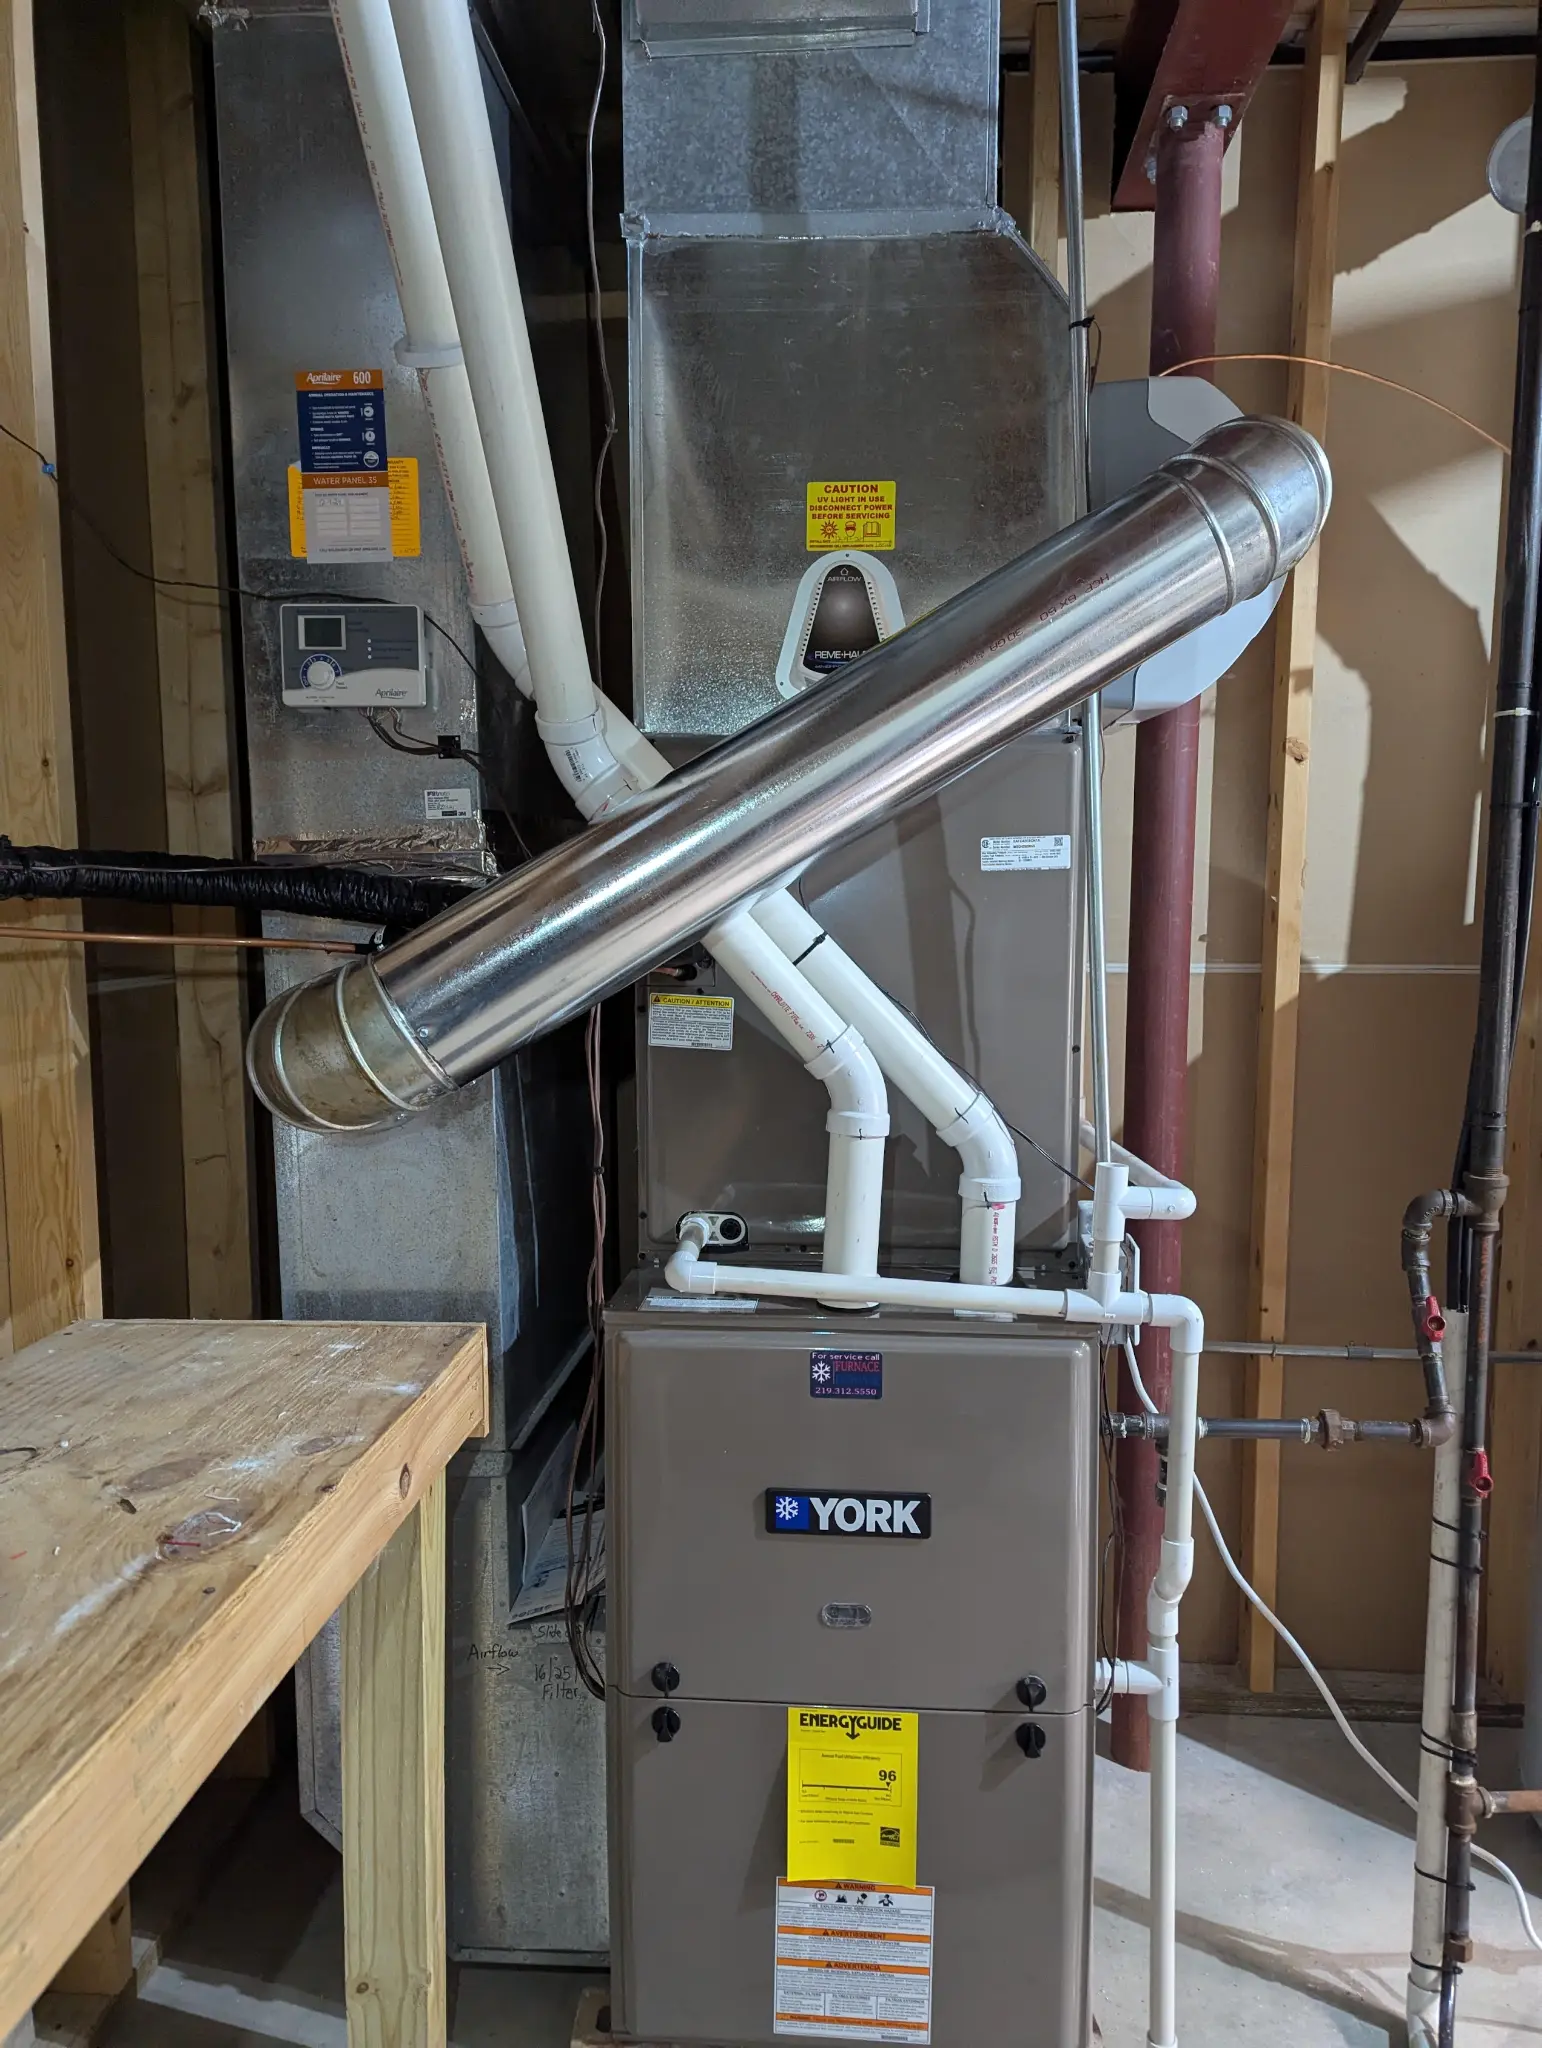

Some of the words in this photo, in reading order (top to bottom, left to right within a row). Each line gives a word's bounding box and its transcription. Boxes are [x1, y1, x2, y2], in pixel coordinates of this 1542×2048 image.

[306, 373, 342, 384] Aprilaire
[353, 371, 371, 384] 600
[313, 477, 340, 485] WATER
[368, 476, 377, 484] 35
[824, 484, 879, 493] CAUTION
[1007, 628, 1024, 642] 30
[989, 638, 1006, 652] GA
[375, 688, 408, 698] Aprilaire
[835, 1360, 880, 1372] FURNACE
[815, 1387, 877, 1396] 219.312.5550
[809, 1497, 921, 1534] YORK
[534, 1623, 562, 1639] Slide
[467, 1644, 519, 1661] Airflow
[542, 1683, 579, 1701] Filter
[799, 1713, 902, 1732] ENERGYGUIDE
[878, 1769, 897, 1782] 96
[830, 1930, 886, 1939] AVERTISSEMENT
[834, 1963, 881, 1971] ADVERTENCIA
